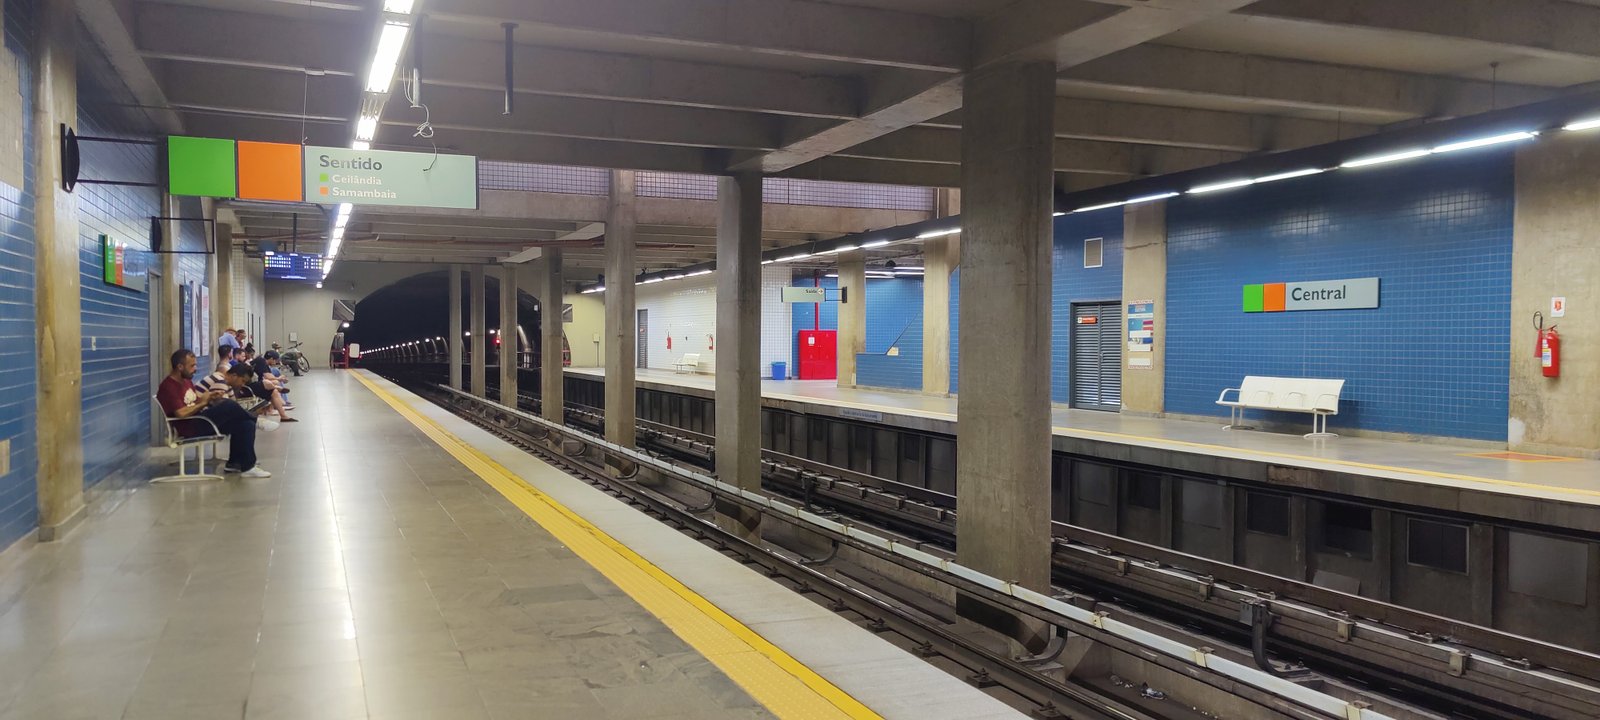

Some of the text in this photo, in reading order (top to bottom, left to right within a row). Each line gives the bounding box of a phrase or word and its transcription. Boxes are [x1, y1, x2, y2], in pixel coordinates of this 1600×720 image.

[319, 154, 383, 171] Sentido
[332, 174, 382, 185] Ceilândia
[332, 187, 397, 199] Samambaia
[1291, 284, 1346, 302] Central
